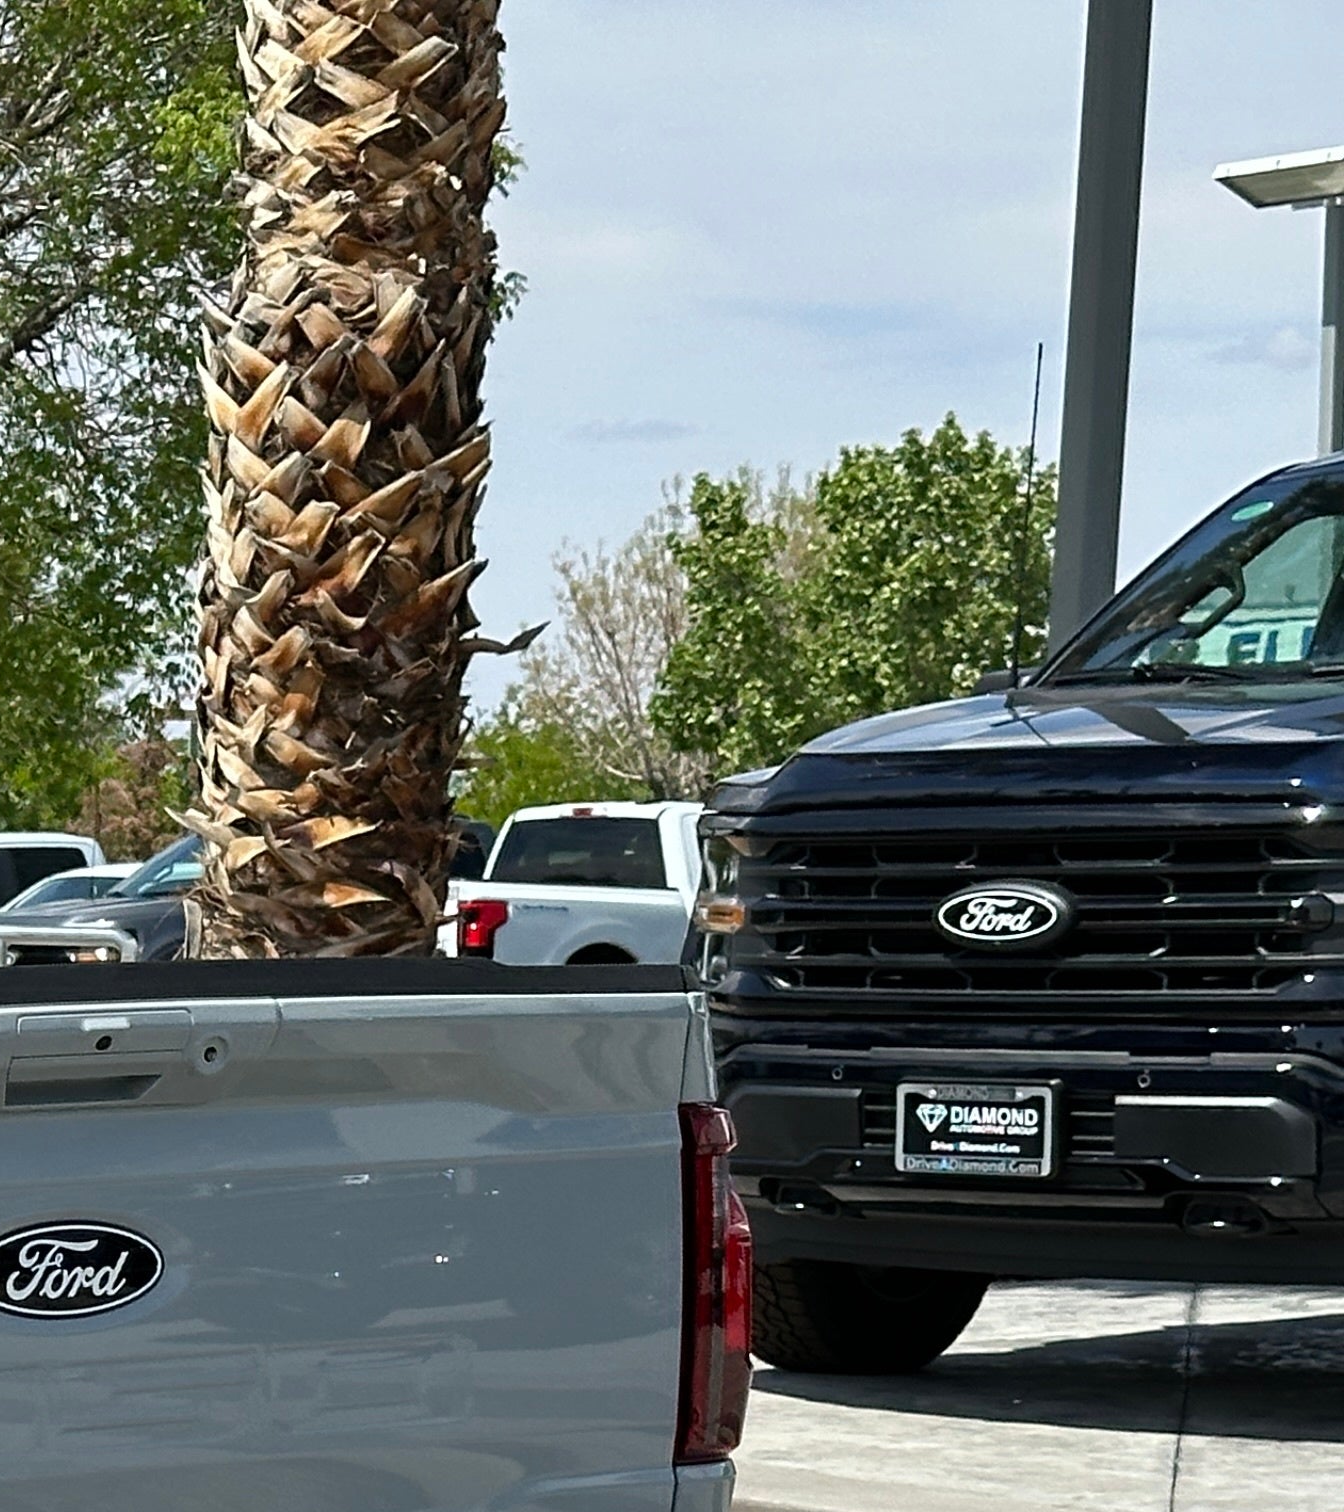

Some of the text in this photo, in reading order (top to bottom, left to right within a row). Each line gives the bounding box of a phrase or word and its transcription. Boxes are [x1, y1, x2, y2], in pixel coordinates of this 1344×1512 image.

[959, 897, 1035, 932] Ford
[949, 1105, 1039, 1127] DIAMOND
[5, 1238, 131, 1301] Ford
